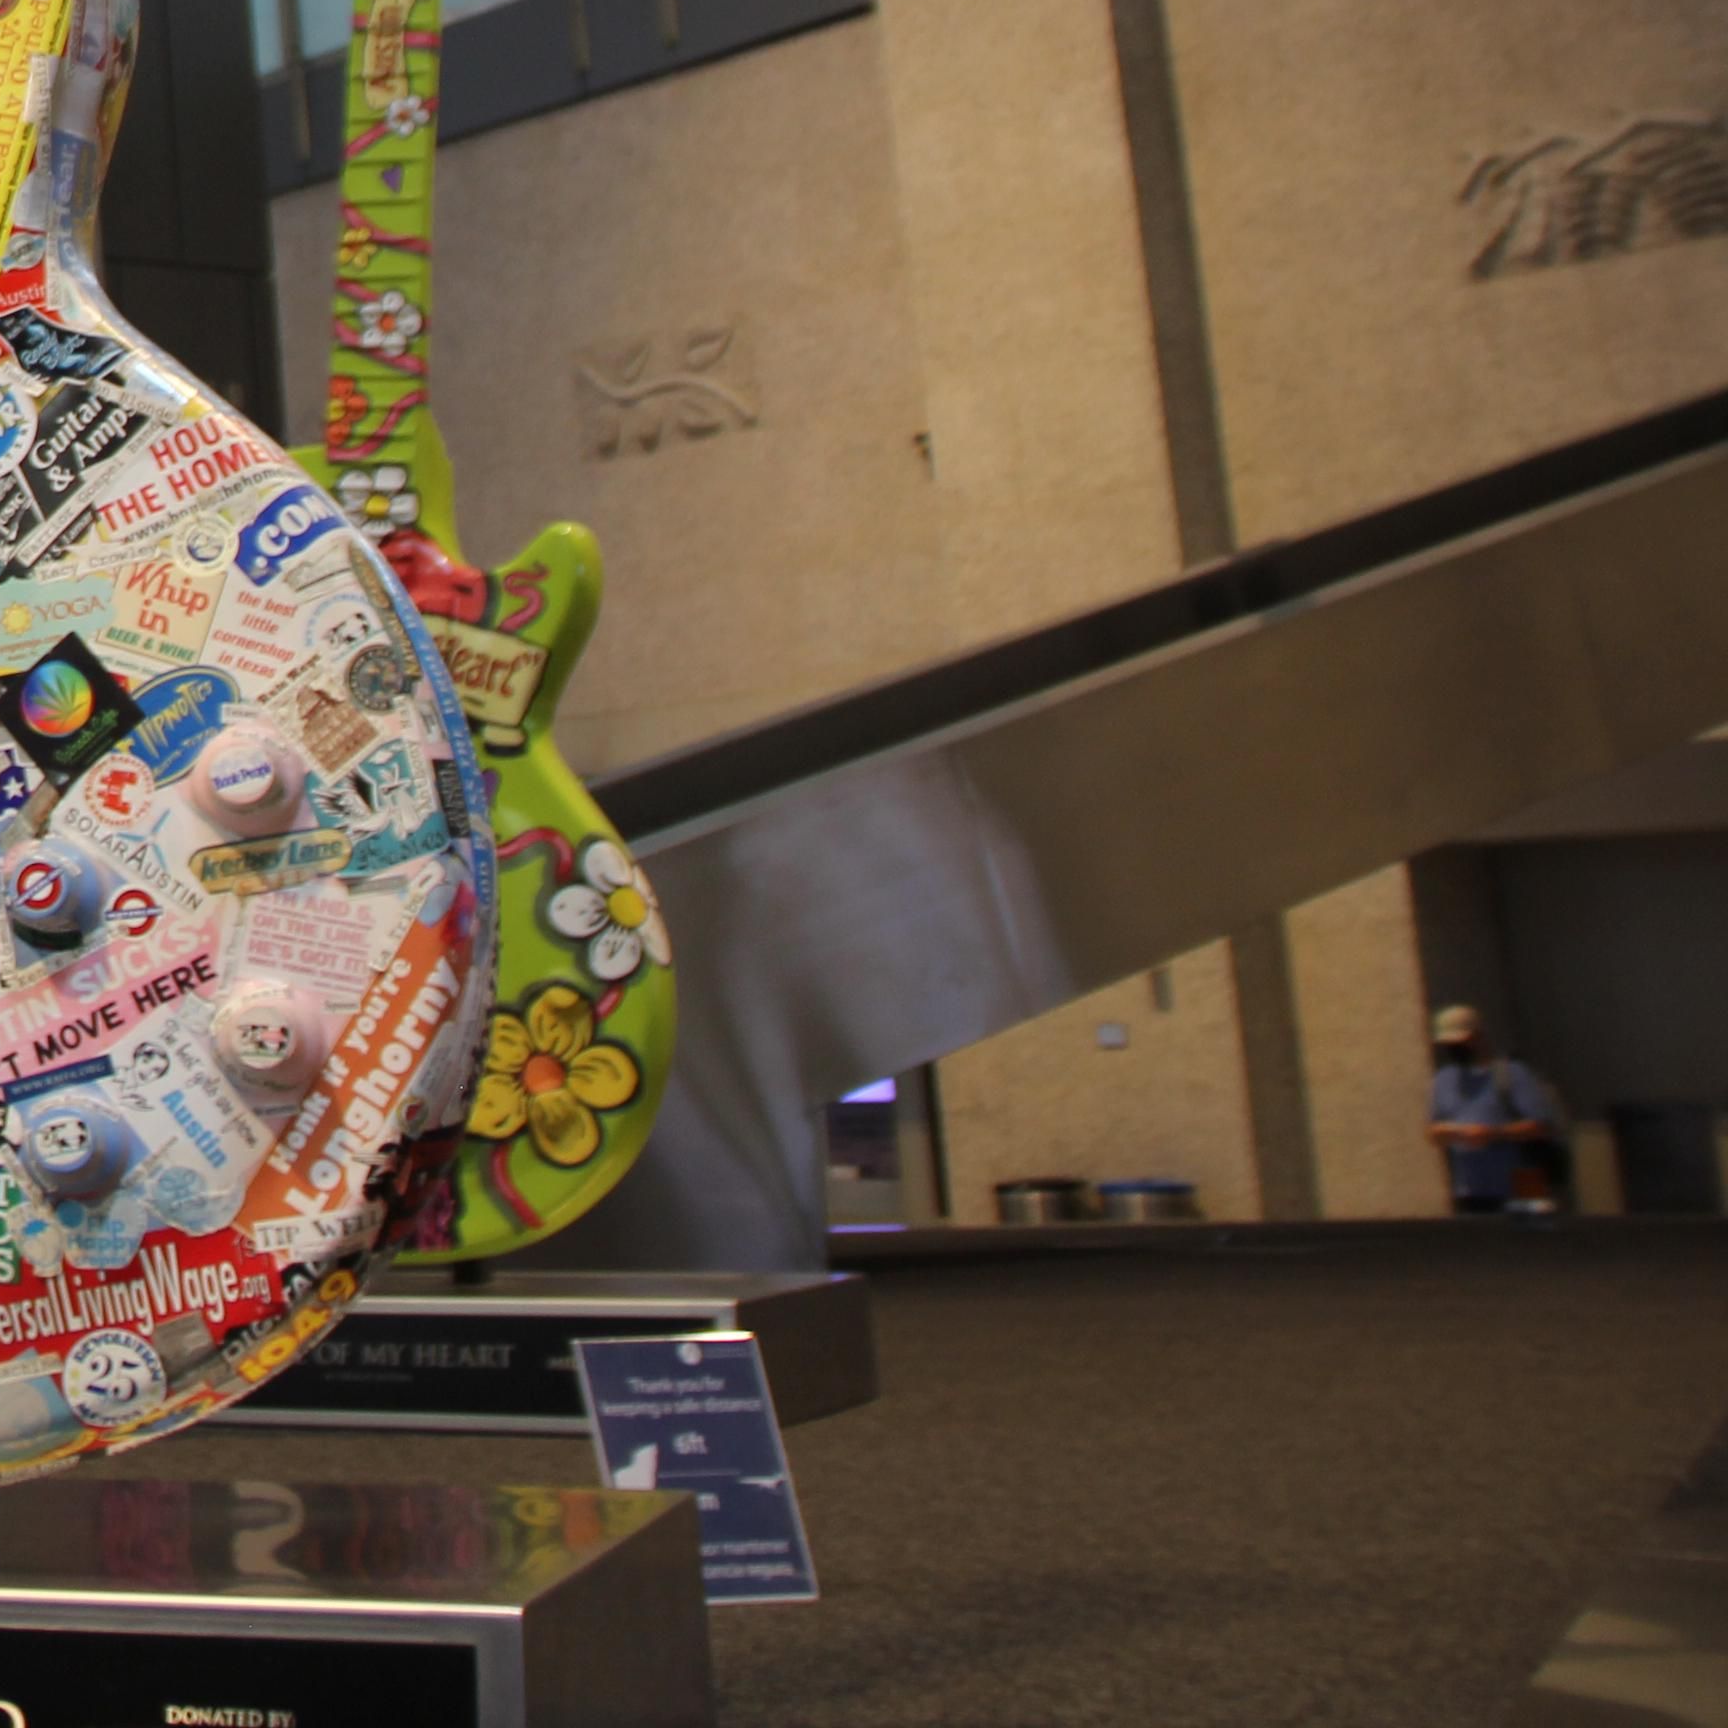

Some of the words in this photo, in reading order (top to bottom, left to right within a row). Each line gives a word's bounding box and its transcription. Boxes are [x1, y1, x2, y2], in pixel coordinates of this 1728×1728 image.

[126, 560, 212, 616] Whip
[237, 588, 264, 607] the
[264, 594, 300, 619] best
[32, 593, 106, 627] YOGA
[137, 600, 170, 638] in
[240, 611, 281, 636] little
[104, 625, 139, 650] BEER
[141, 636, 156, 653] &
[156, 639, 198, 665] WINE
[212, 626, 297, 664] cornershop
[216, 648, 234, 665] in
[236, 653, 279, 679] texas
[64, 806, 128, 862] SOLAR
[126, 844, 203, 912] AUSTIN
[33, 1002, 126, 1067] MOVE
[130, 954, 219, 1017] HERE
[161, 1087, 229, 1171] Austin
[362, 1342, 406, 1367] MY
[411, 1342, 518, 1370] HEART
[85, 1355, 140, 1403] 25
[164, 1703, 264, 1728] DONATED
